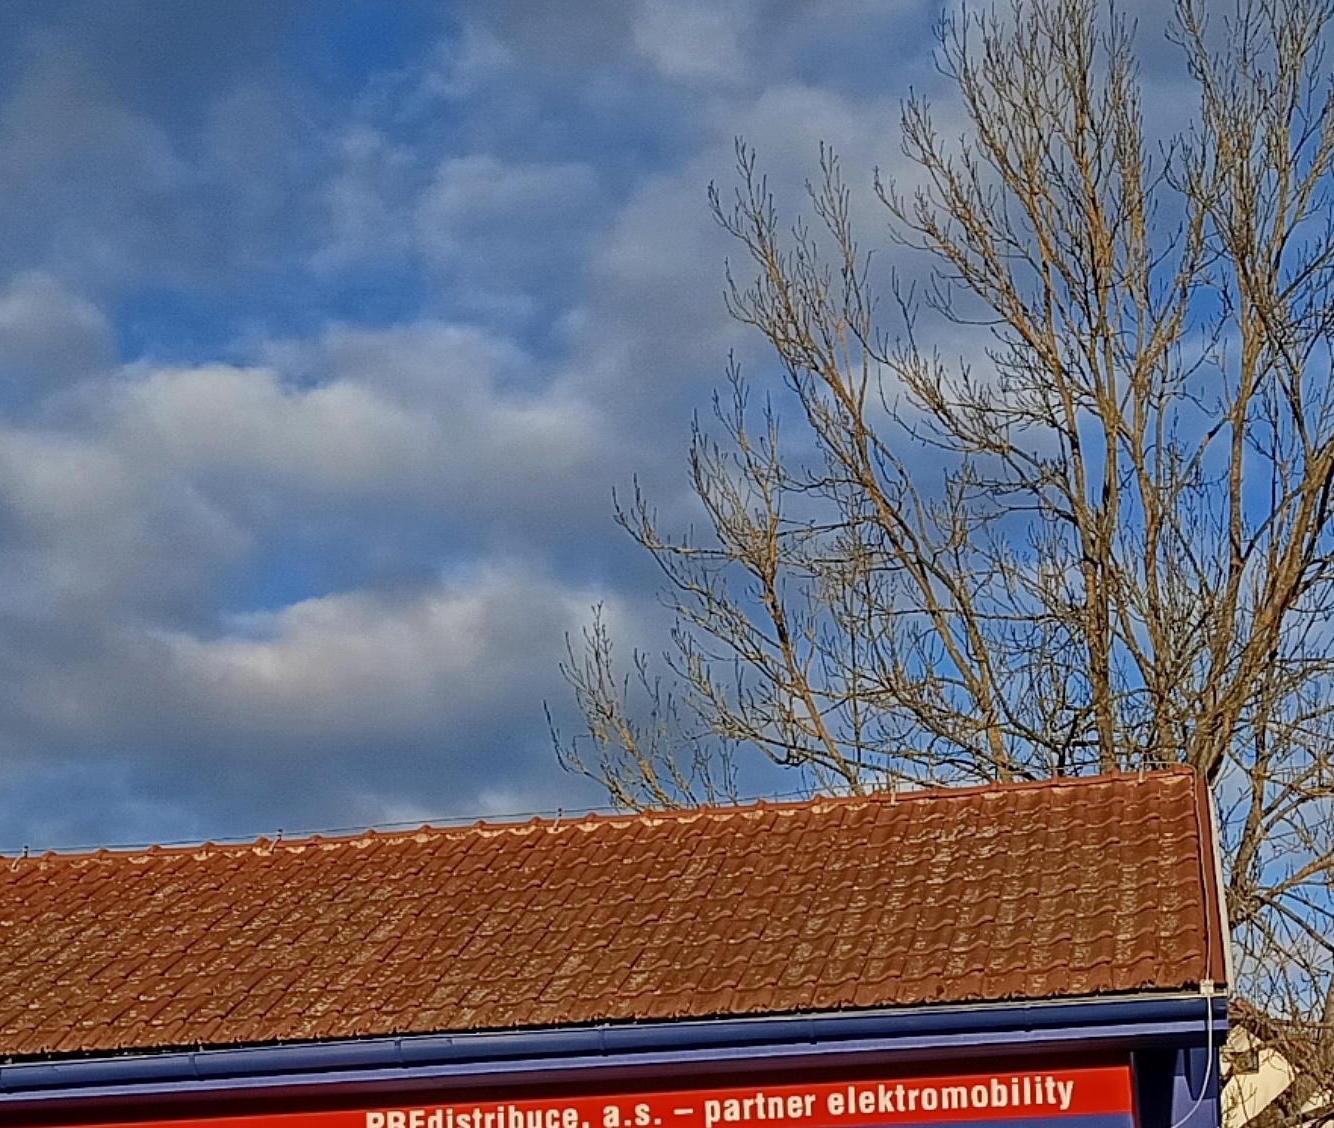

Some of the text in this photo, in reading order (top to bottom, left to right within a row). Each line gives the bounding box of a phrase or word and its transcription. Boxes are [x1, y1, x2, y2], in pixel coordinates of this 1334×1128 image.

[603, 1103, 662, 1128] a.s.
[704, 1093, 816, 1128] partner
[827, 1075, 1074, 1115] elektromobility
